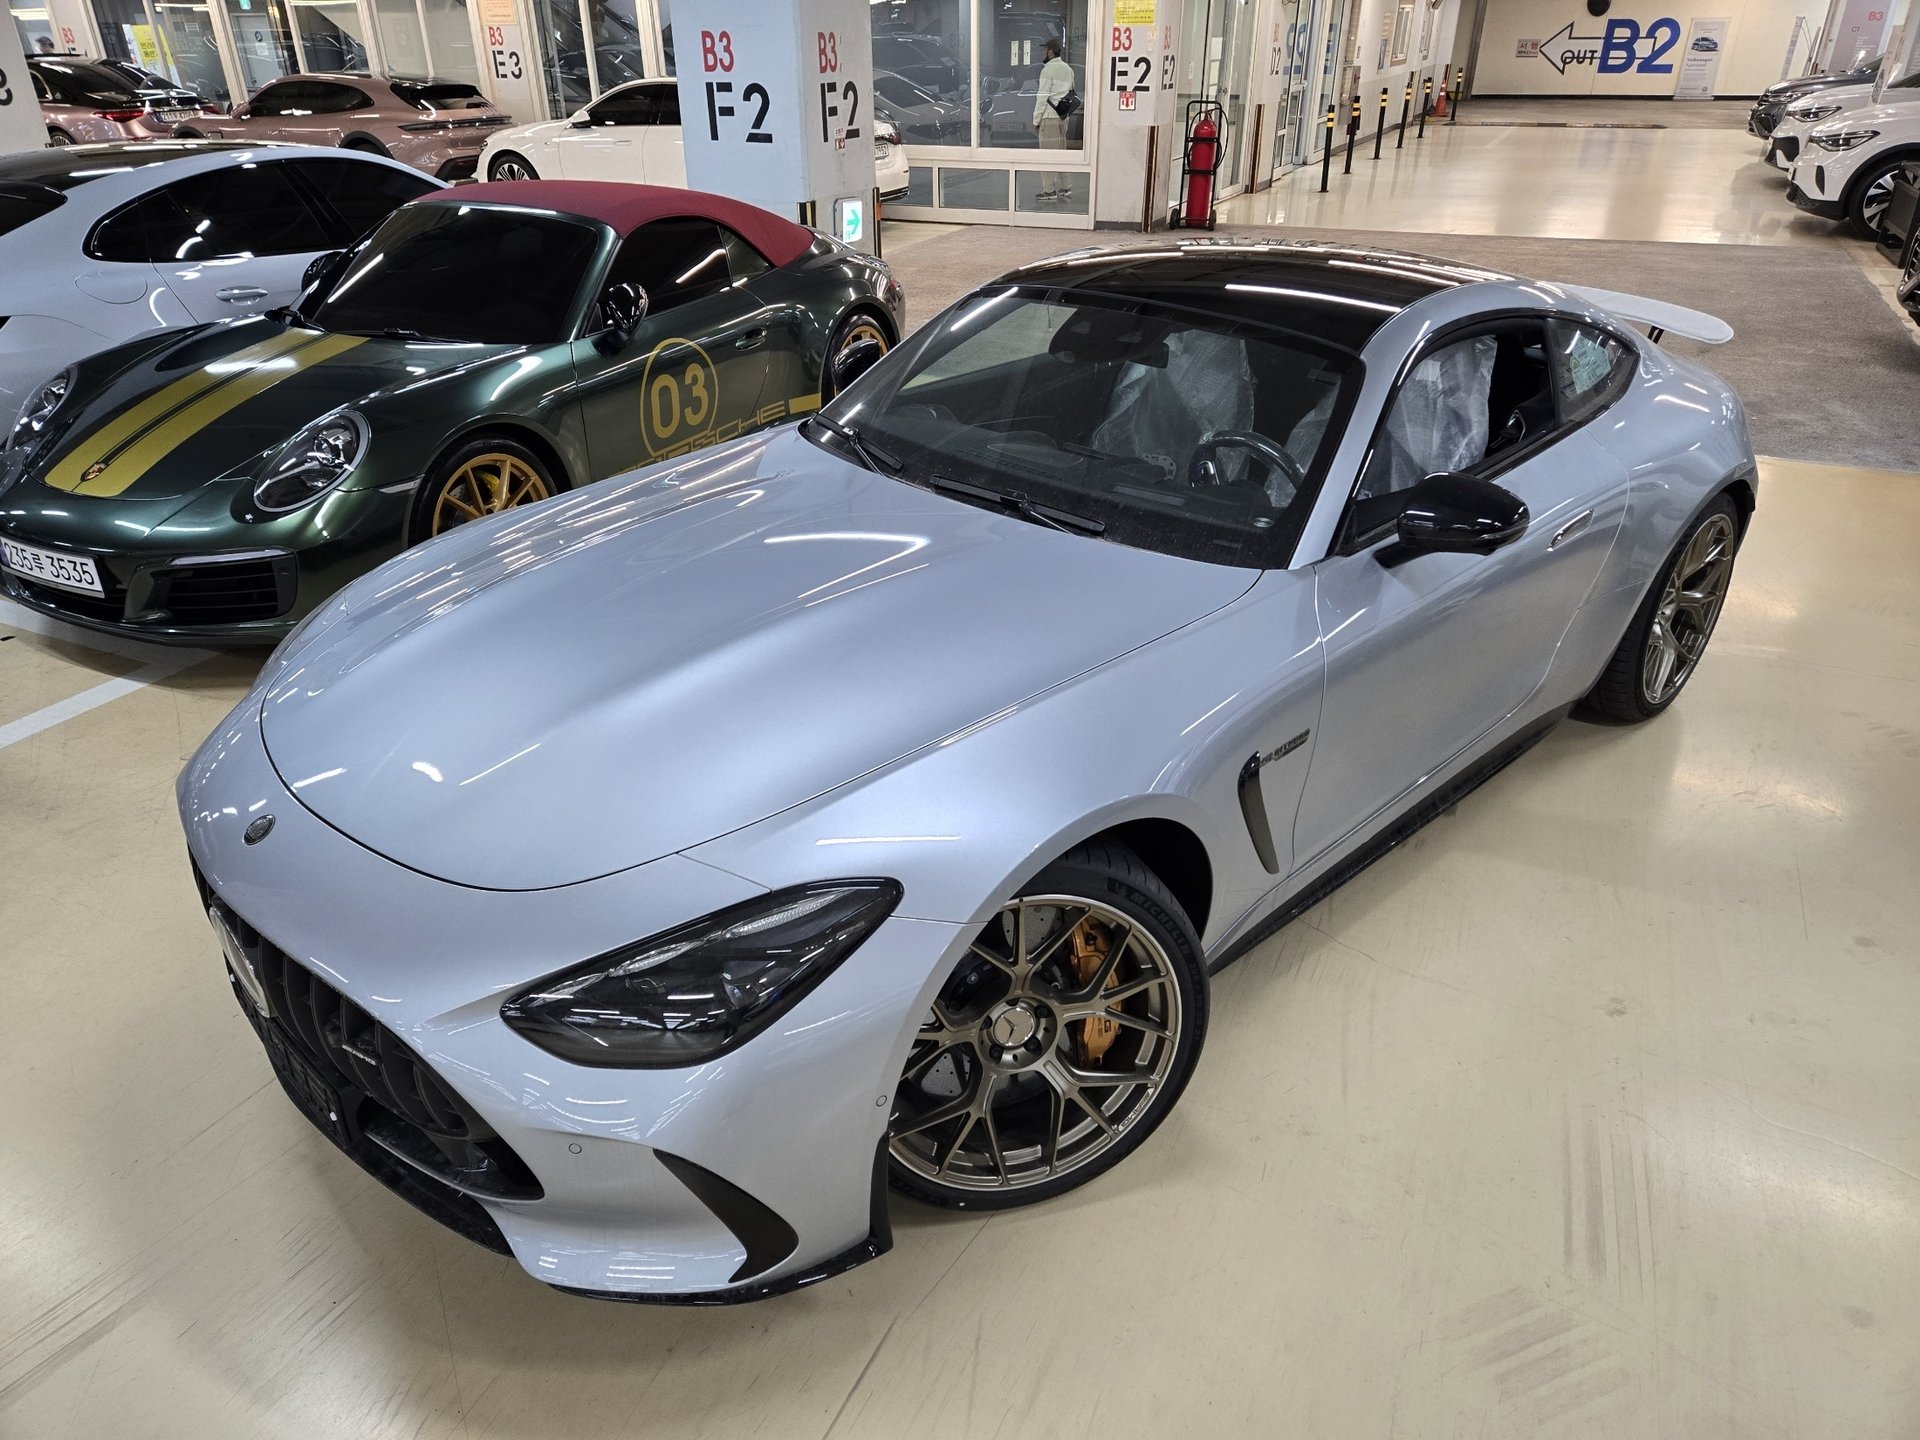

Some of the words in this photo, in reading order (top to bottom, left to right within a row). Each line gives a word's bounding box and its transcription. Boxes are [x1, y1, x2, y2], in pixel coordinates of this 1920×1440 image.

[1868, 10, 1884, 21] B3
[488, 26, 504, 46] B3
[701, 30, 734, 73] B3
[817, 31, 838, 74] B3
[1112, 26, 1133, 52] B3
[1597, 17, 1681, 74] B2
[492, 50, 523, 79] E3
[1109, 56, 1152, 92] E2
[1161, 54, 1176, 91] E2
[1560, 49, 1598, 65] OUT
[705, 81, 773, 144] F2
[820, 80, 860, 143] F2
[651, 362, 709, 439] 03
[4, 543, 45, 574] 235루
[46, 555, 95, 585] 3535
